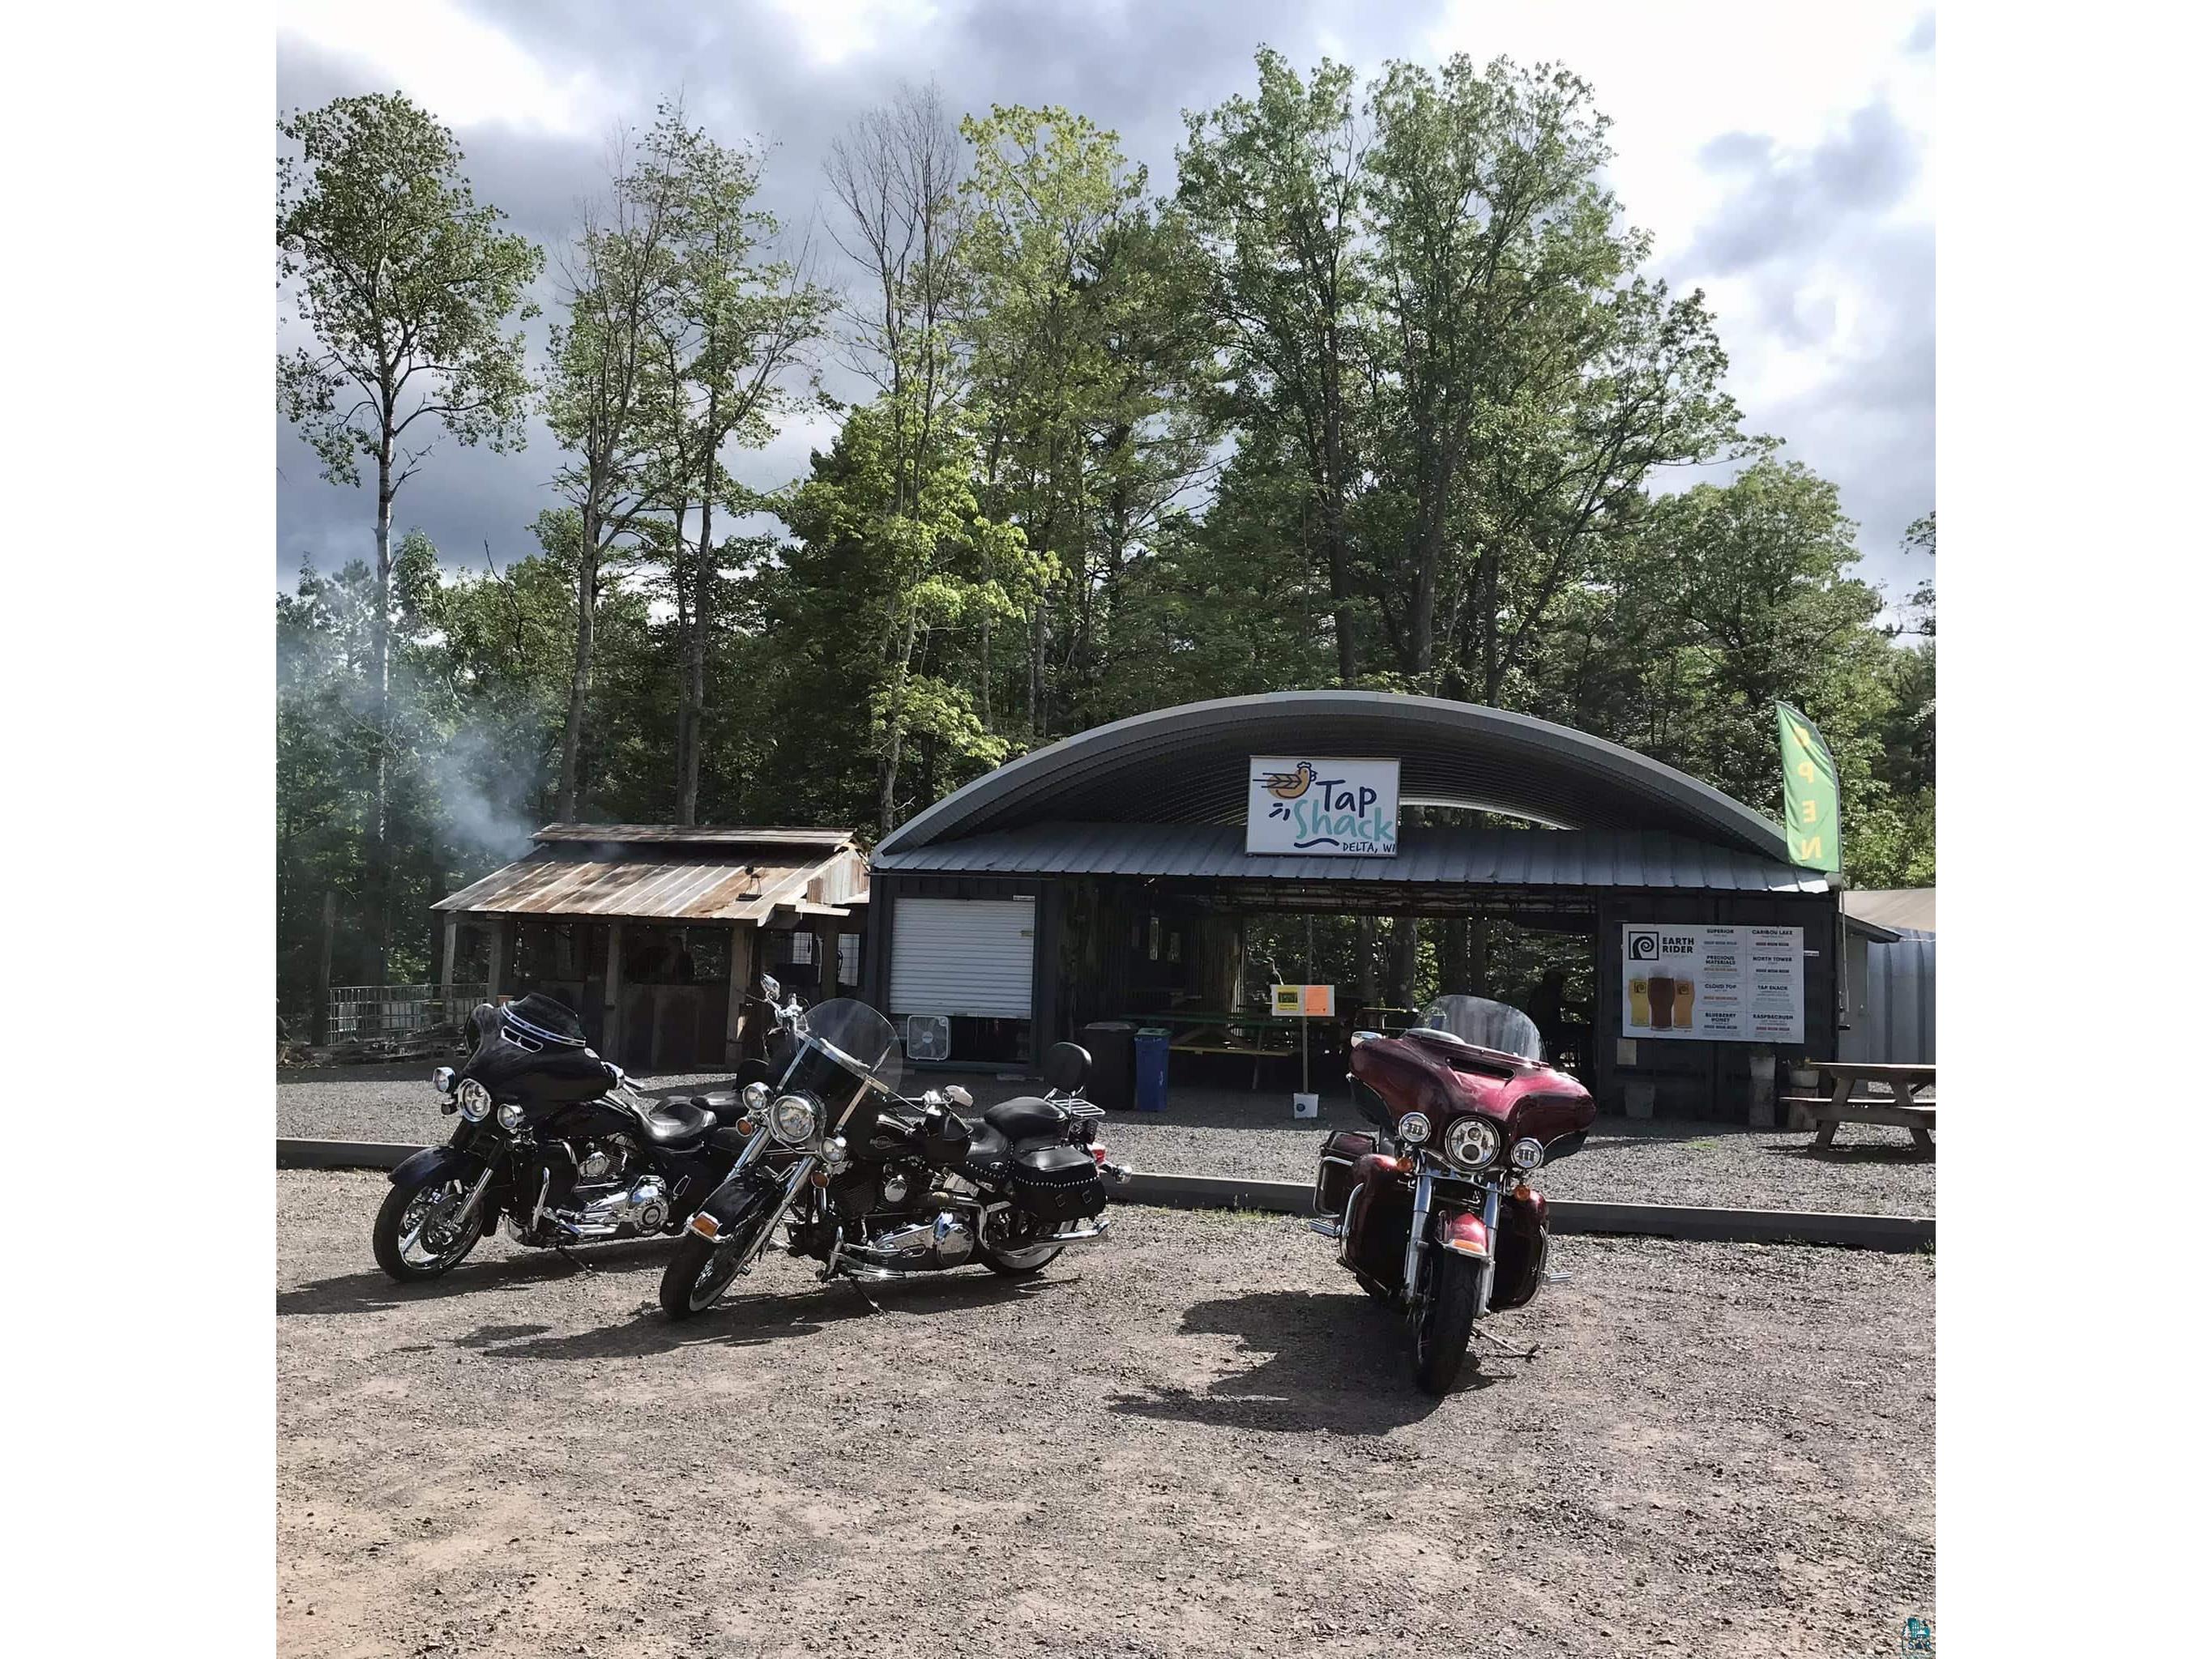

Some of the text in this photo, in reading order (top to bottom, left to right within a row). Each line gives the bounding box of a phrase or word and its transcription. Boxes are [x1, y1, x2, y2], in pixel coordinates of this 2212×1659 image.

[1315, 779, 1377, 818] Tap
[1294, 799, 1394, 842] Shack
[1343, 842, 1396, 854] DELTA, WI
[1662, 936, 1695, 945] EARTH
[1662, 945, 1693, 953] RIDER
